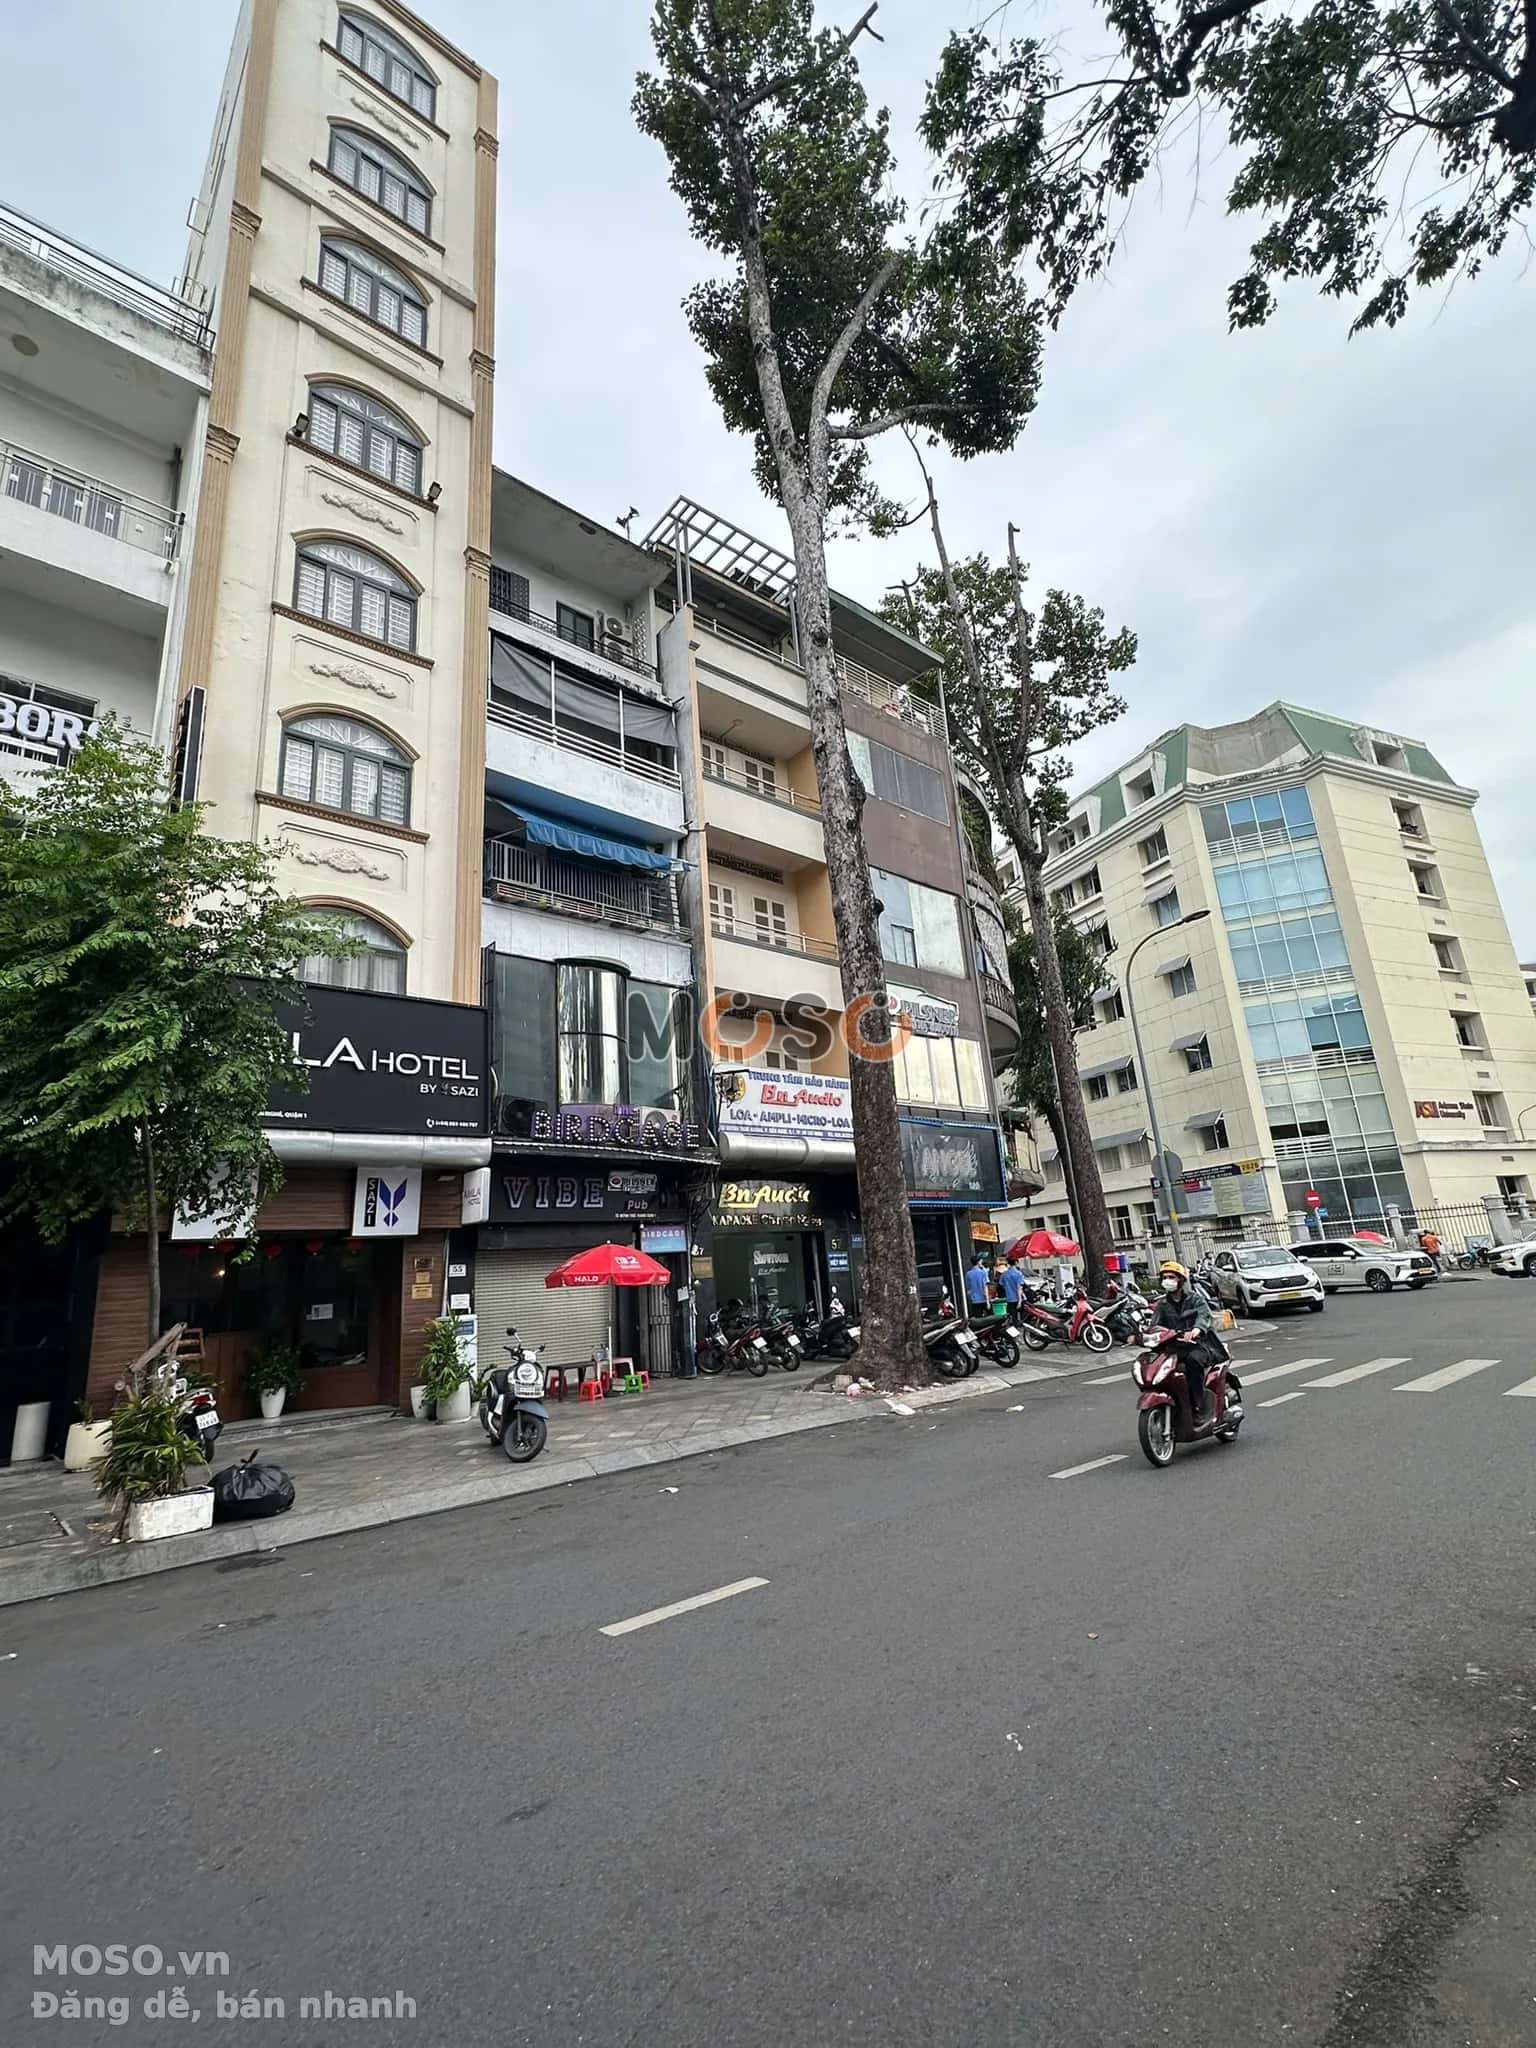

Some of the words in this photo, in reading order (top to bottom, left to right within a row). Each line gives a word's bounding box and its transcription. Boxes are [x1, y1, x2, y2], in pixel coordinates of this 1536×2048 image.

[371, 1050, 480, 1081] HOTEL
[420, 1083, 437, 1094] BY
[450, 1086, 479, 1097] SAZI
[534, 1109, 701, 1148] BIRDCAGE
[367, 1178, 377, 1225] SAZI
[504, 1176, 604, 1208] VIBE
